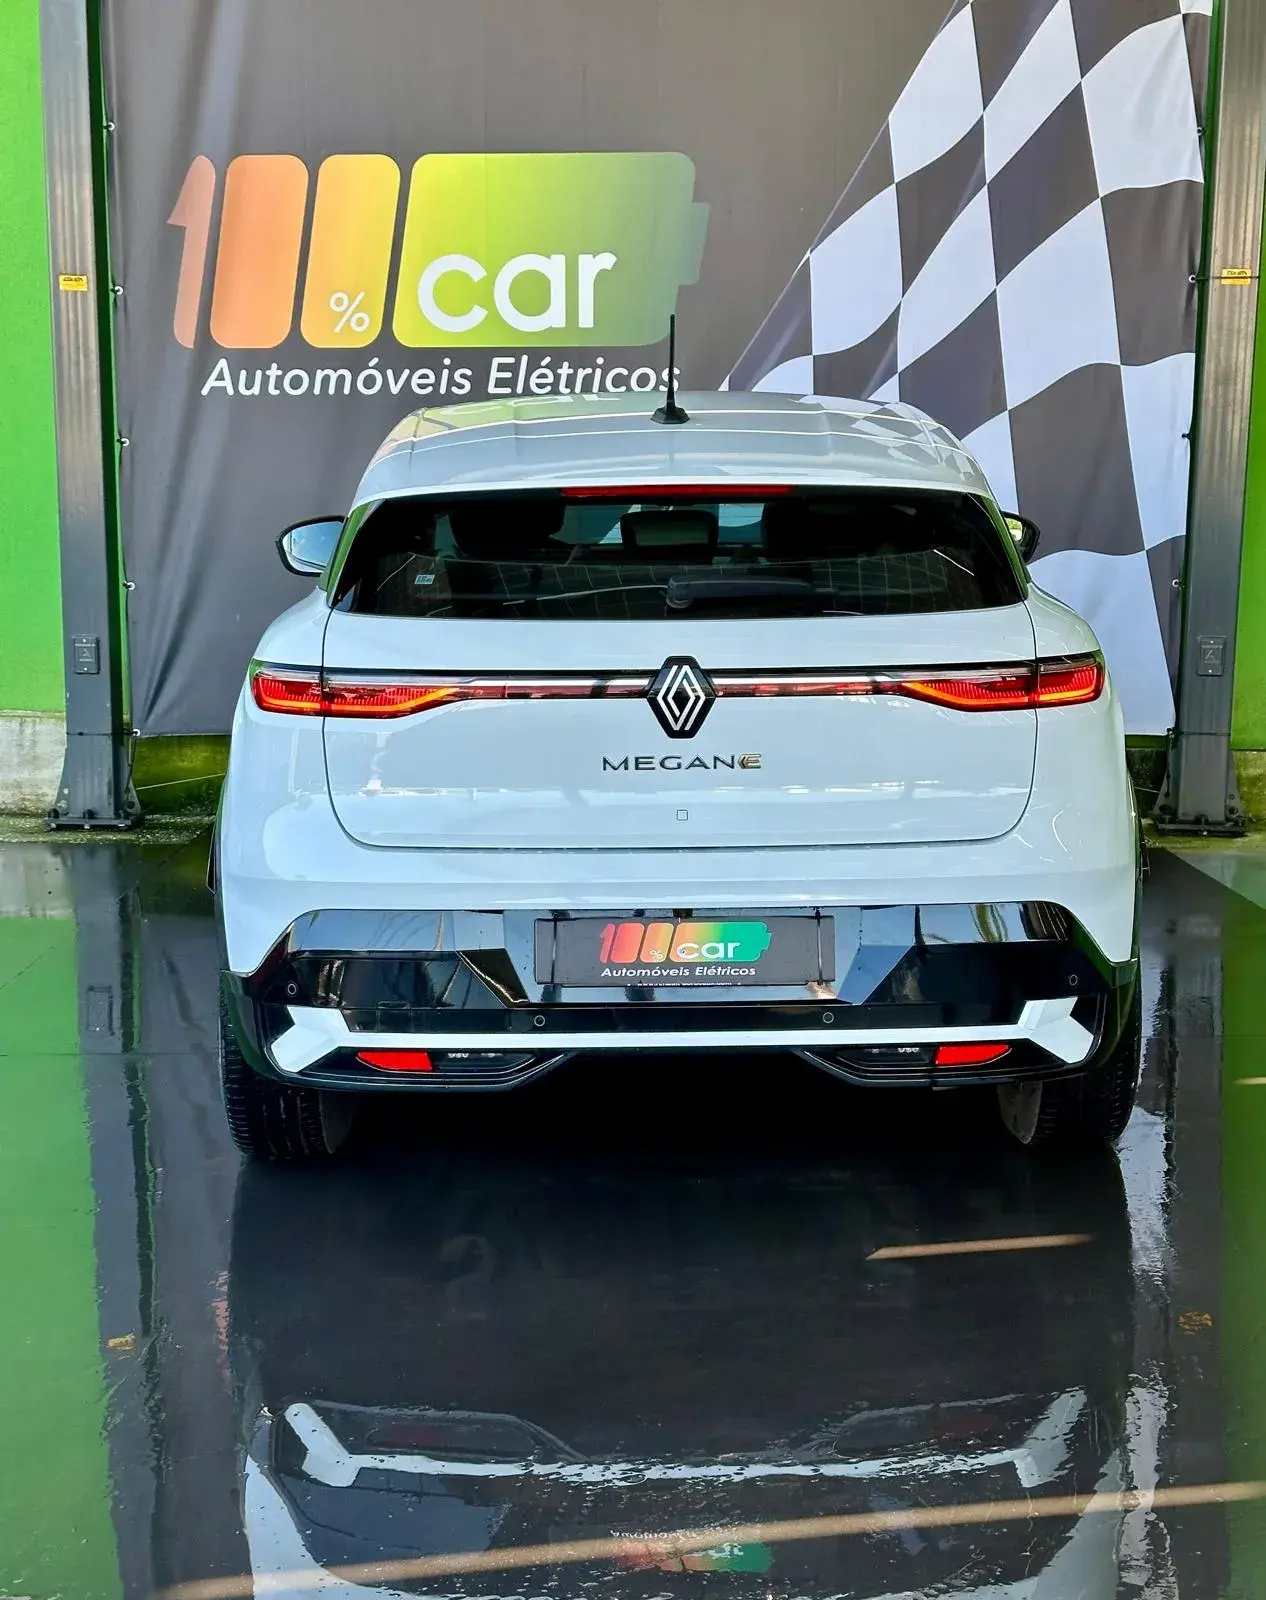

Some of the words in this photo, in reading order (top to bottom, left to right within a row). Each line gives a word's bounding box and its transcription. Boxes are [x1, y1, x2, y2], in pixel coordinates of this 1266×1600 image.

[418, 250, 618, 332] car
[200, 357, 472, 396] Automóveis
[487, 354, 681, 394] Elétricos
[602, 753, 762, 771] MEGANE
[676, 940, 742, 960] car
[600, 966, 690, 978] Automóveis
[695, 965, 756, 976] Elétricos
